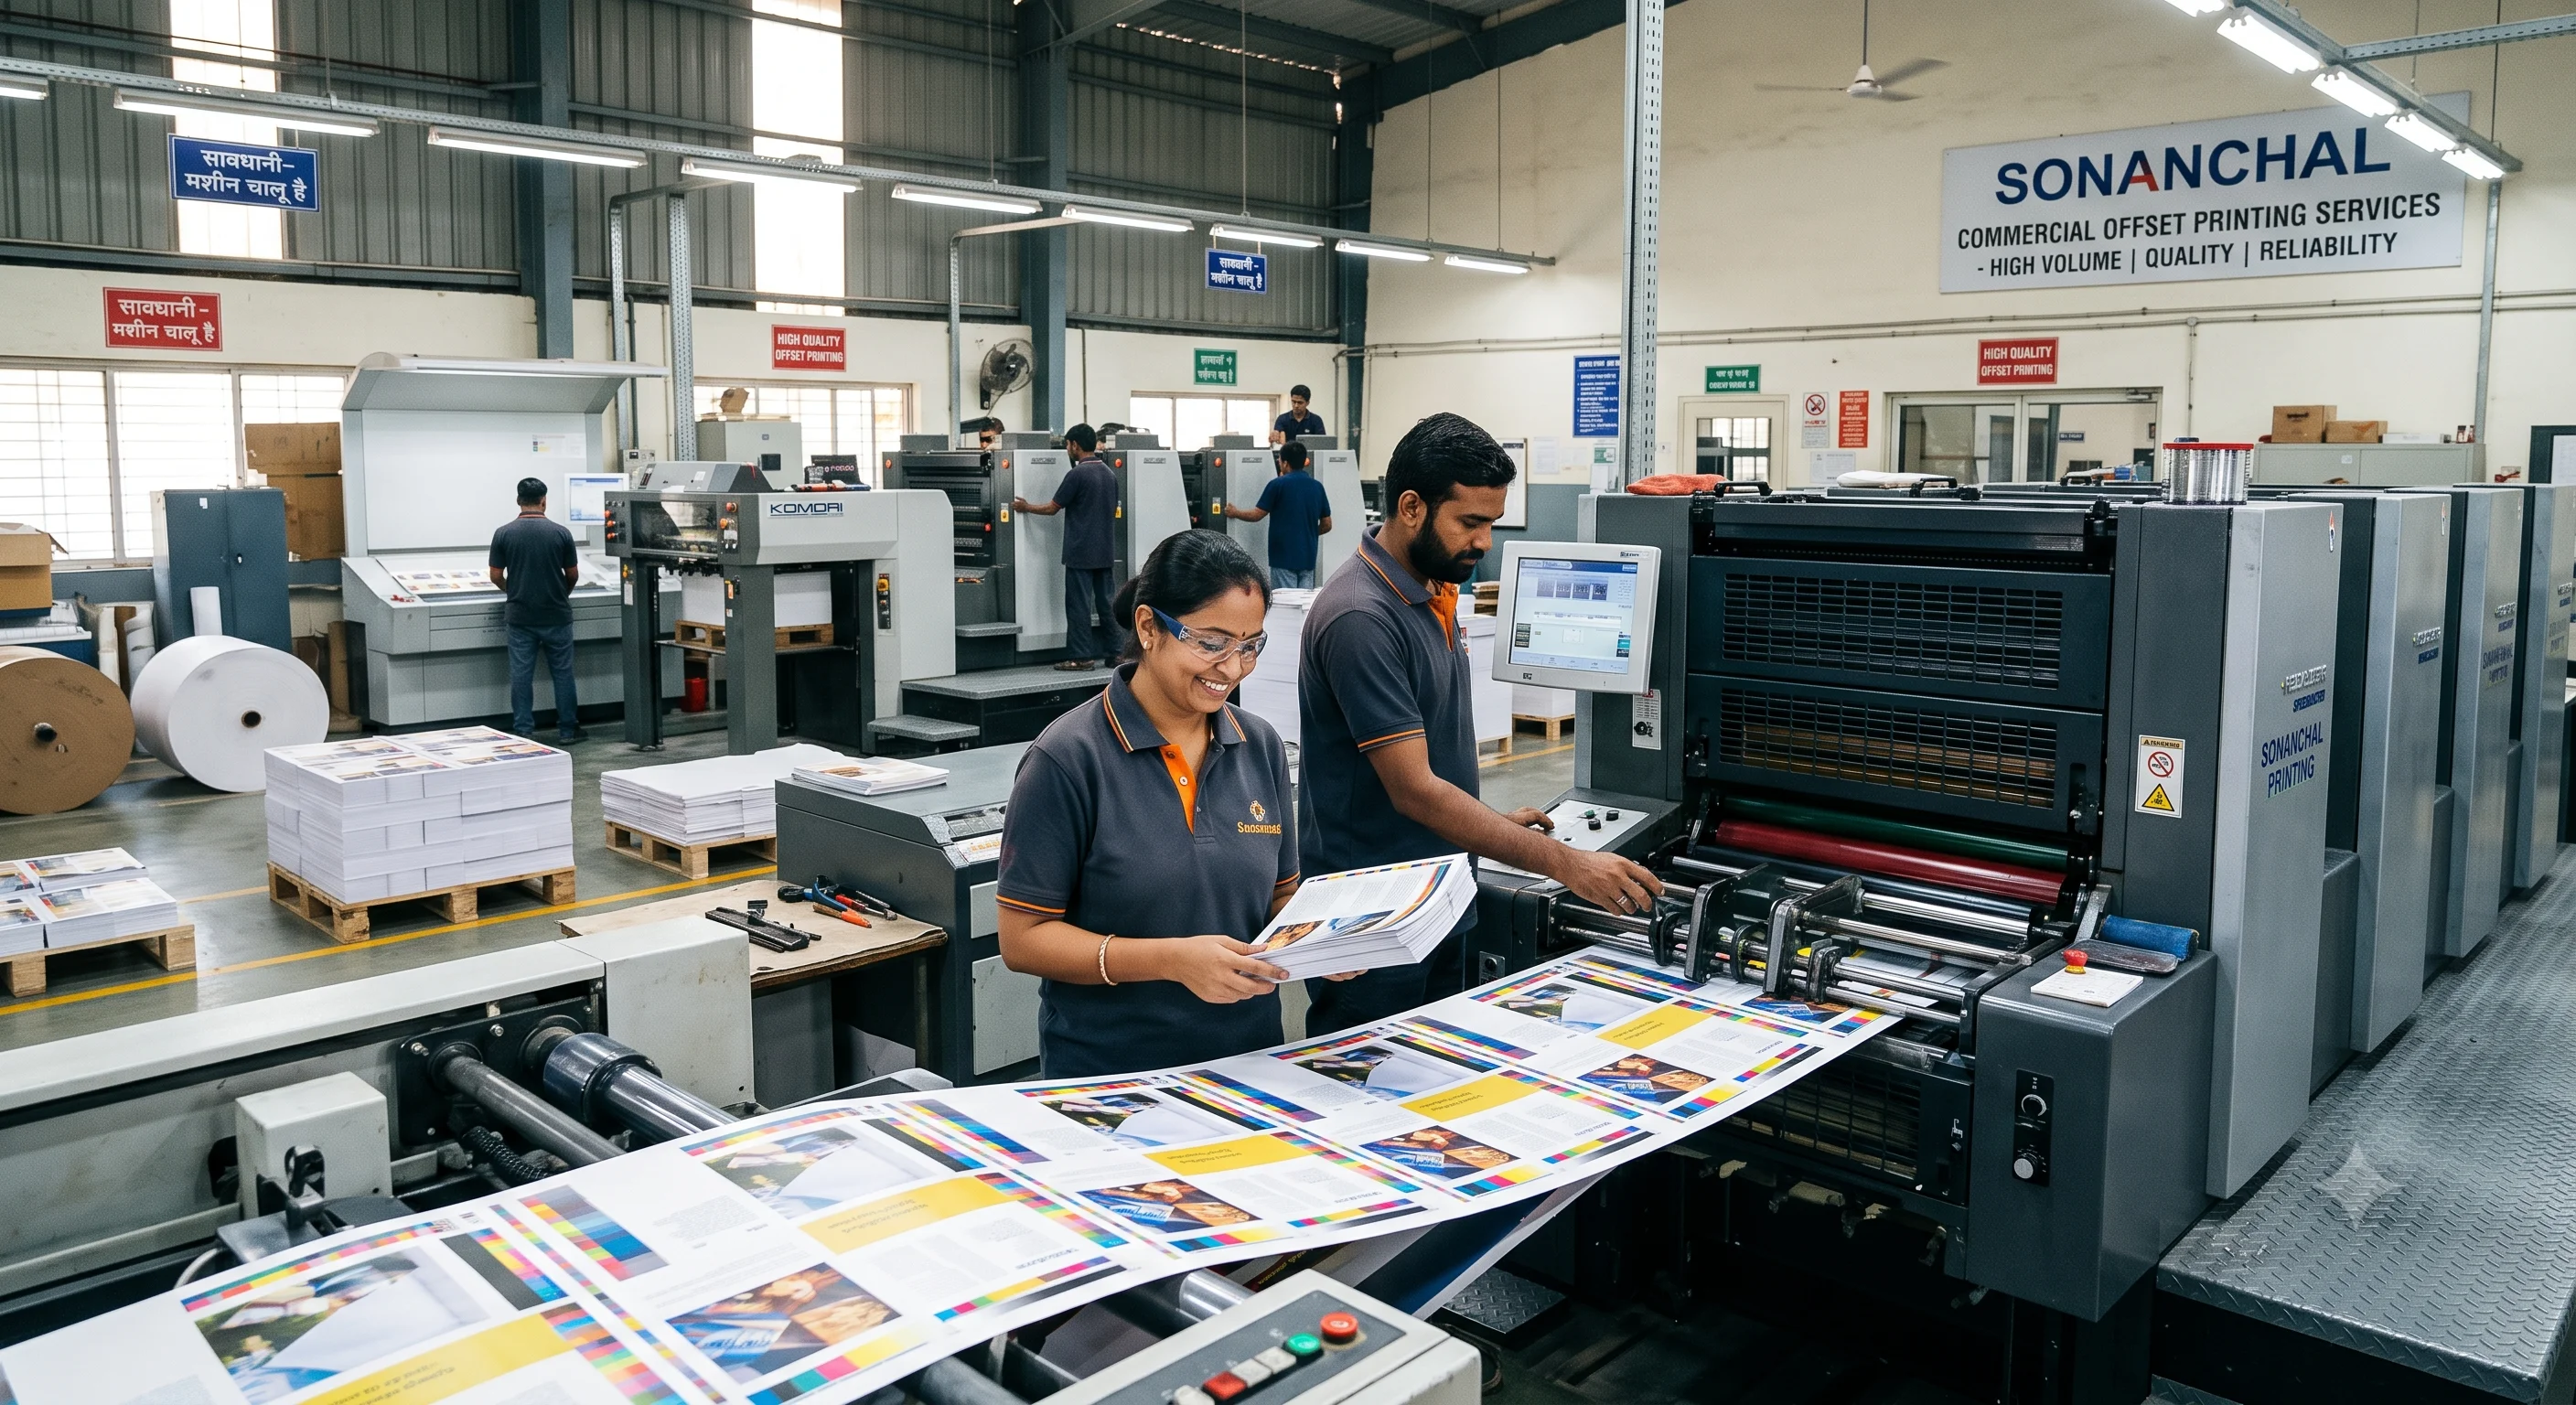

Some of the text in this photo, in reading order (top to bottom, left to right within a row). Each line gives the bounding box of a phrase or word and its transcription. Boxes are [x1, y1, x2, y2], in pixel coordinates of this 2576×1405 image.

[1995, 127, 2390, 205] SONANCHAL
[184, 170, 308, 205] मशीन चालू है
[1958, 192, 2441, 250] COMMERCIAL OFFSET PRINTING SERVICES
[1991, 256, 2034, 277] HIGH
[2042, 251, 2121, 273] VOLUME
[2145, 243, 2234, 268] QUALITY
[2260, 232, 2398, 262] RELIABILITY
[117, 296, 196, 317] सावधानी
[113, 318, 215, 345] मशीन चालू है
[778, 333, 841, 347] HIGH QUALITY
[775, 349, 843, 363] OFFSET PRINTING
[1983, 346, 2053, 359] HIGH QUALITY
[1980, 363, 2054, 377] OFFSET PRINTING
[2261, 721, 2324, 767] SONANCHAL
[2268, 754, 2314, 799] PRINTING
